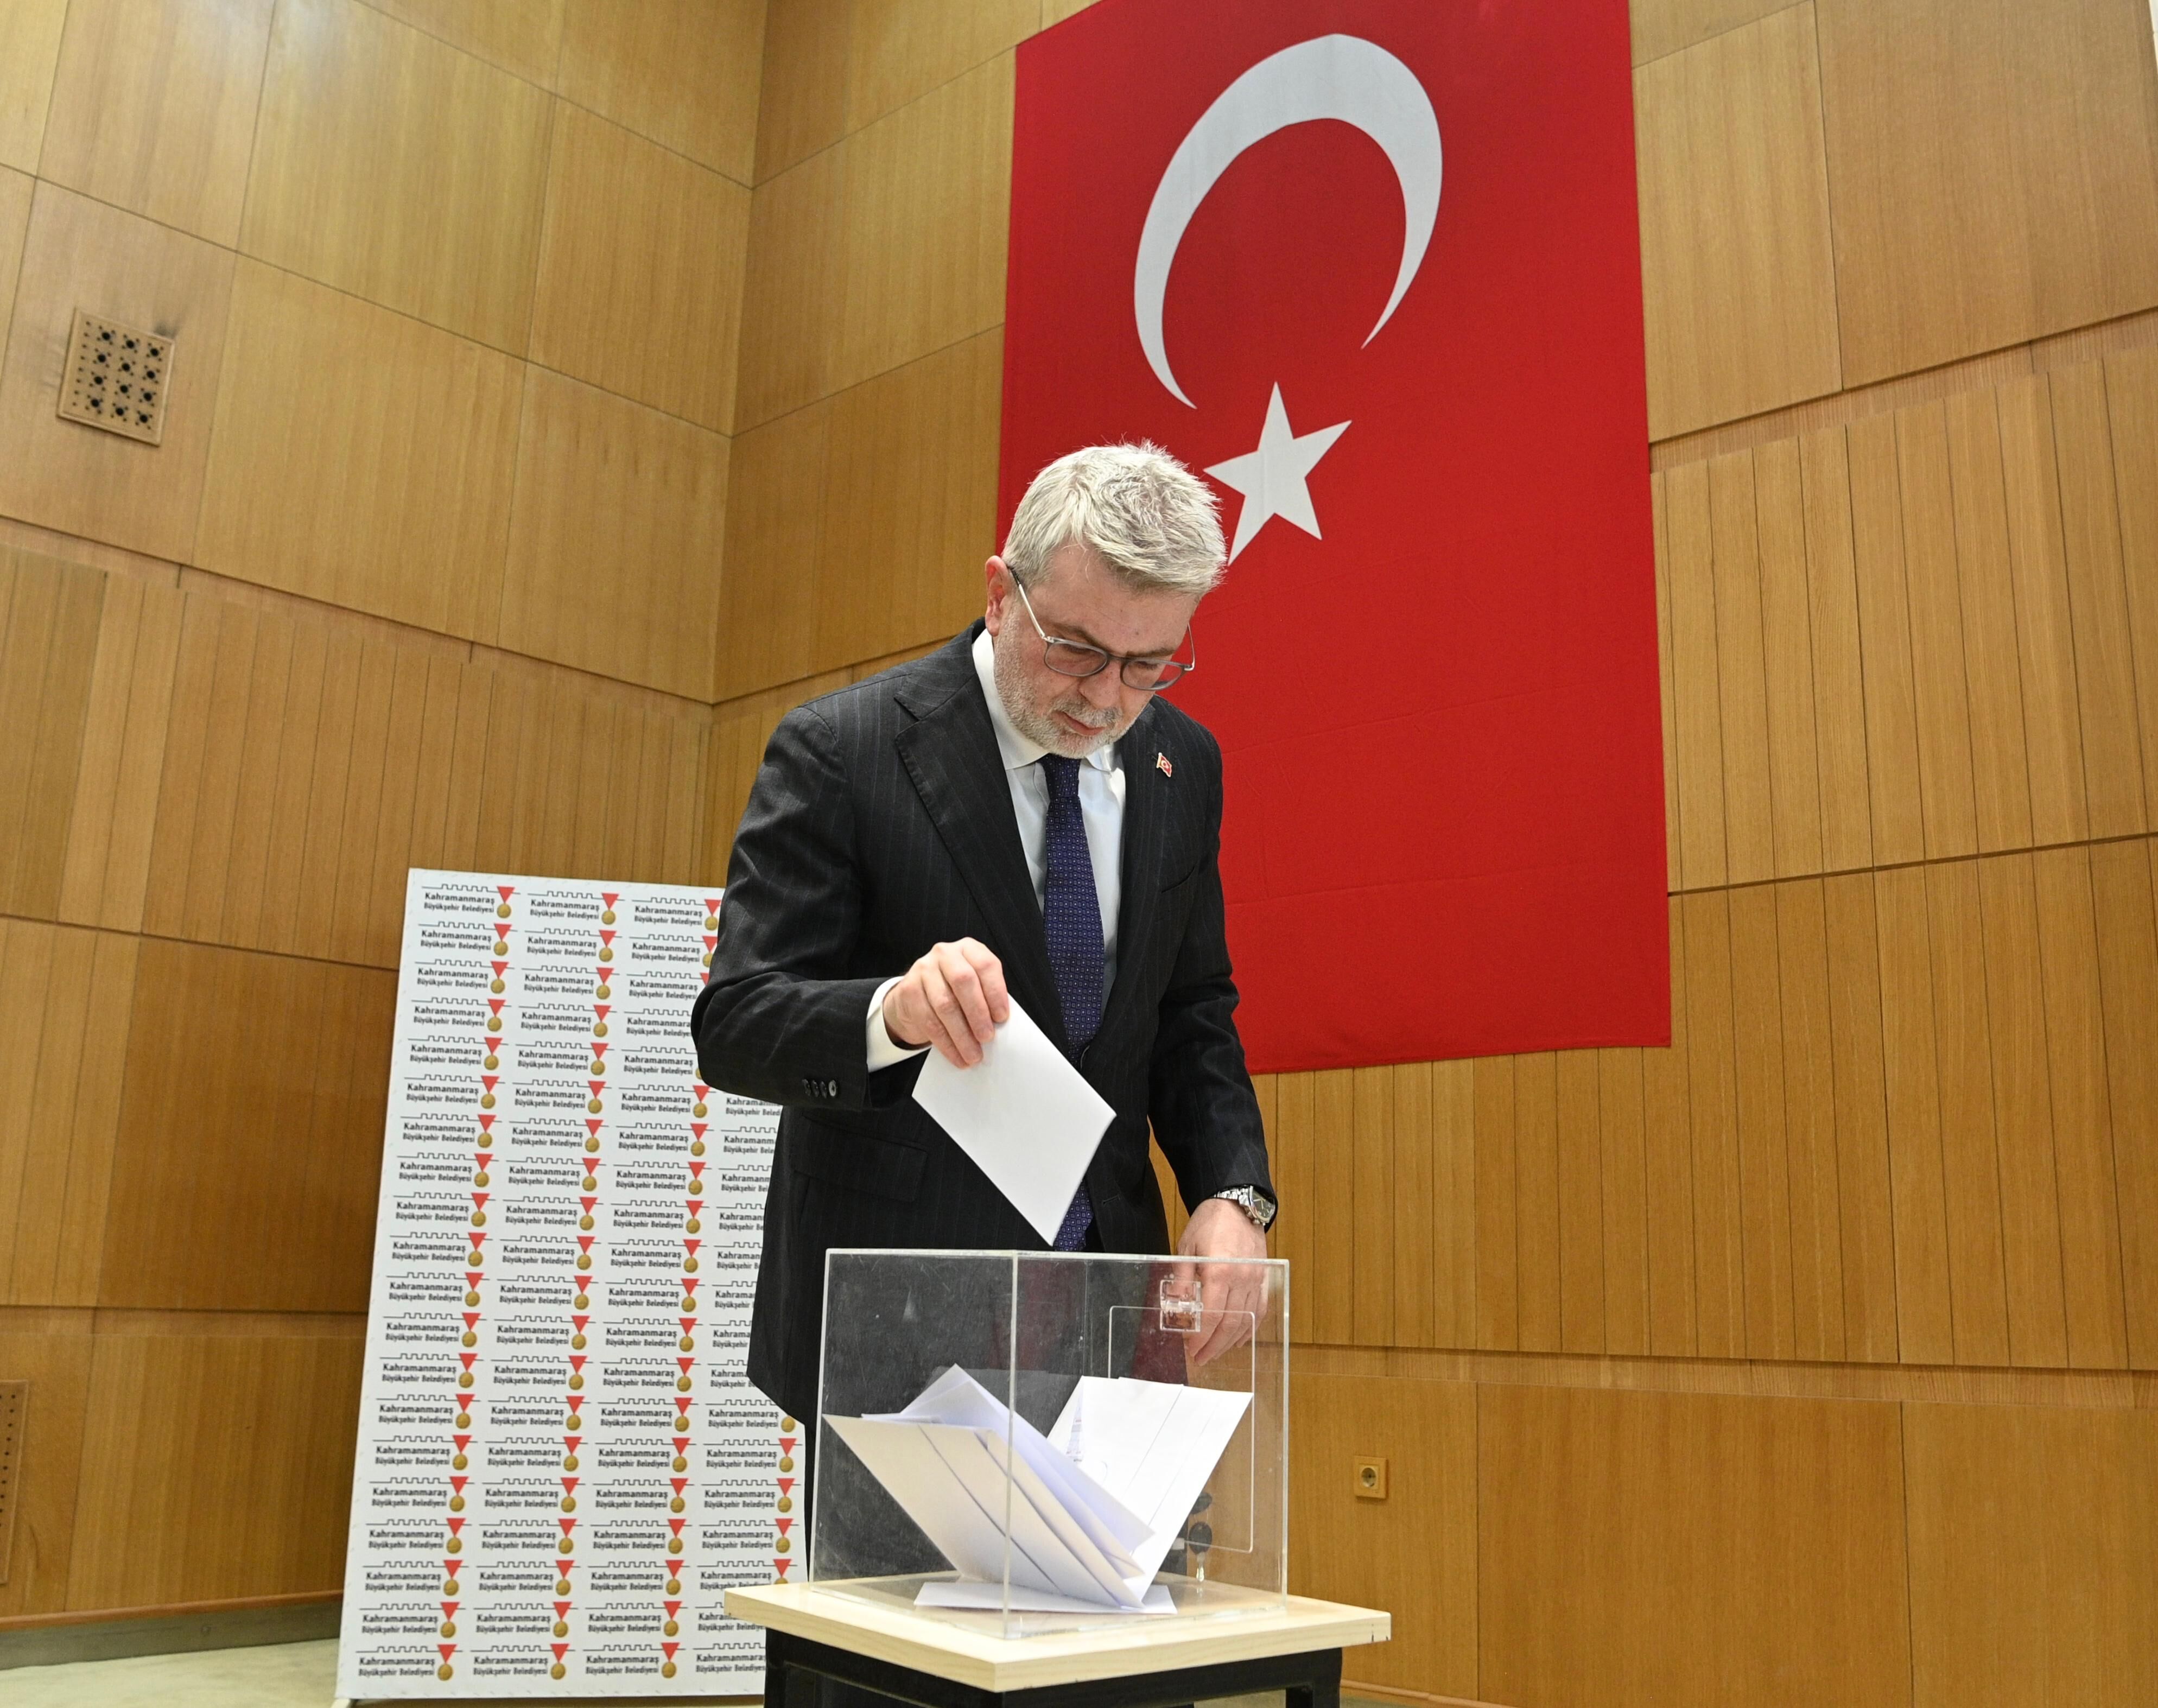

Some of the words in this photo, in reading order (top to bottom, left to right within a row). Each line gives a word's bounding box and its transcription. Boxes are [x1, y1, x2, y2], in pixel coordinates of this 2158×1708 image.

[424, 892, 495, 905] Kahramanmaraş
[423, 901, 460, 912] Büyükşehir
[461, 904, 495, 914] Belediyesi
[530, 898, 600, 912] Kahramanmaraş
[529, 909, 565, 919] Büyükşehir
[567, 910, 600, 921] Belediyesi
[634, 905, 702, 918] Kahramanmaraş
[421, 929, 492, 942] Kahramanmaraş
[420, 939, 456, 950] Büyükşehir
[458, 941, 492, 951] Belediyesi
[527, 936, 597, 949] Kahramanmaraş
[526, 945, 562, 956] Büyükşehir
[564, 948, 597, 958] Belediyesi
[632, 942, 700, 955] Kahramanmaraş
[417, 967, 488, 980] Kahramanmaraş
[416, 977, 453, 988] Büyükşehir
[454, 979, 488, 989] Belediyesi
[524, 973, 594, 986] Kahramanmaraş
[524, 983, 560, 994] Büyükşehir
[561, 985, 594, 995] Belediyesi
[630, 979, 698, 992] Kahramanmaraş
[414, 1005, 485, 1018] Kahramanmaraş
[413, 1015, 450, 1026] Büyükşehir
[451, 1017, 485, 1027] Belediyesi
[521, 1011, 592, 1024] Kahramanmaraş
[521, 1021, 556, 1032] Büyükşehir
[558, 1023, 591, 1033] Belediyesi
[410, 1044, 483, 1057] Kahramanmaraş
[518, 1049, 589, 1062] Kahramanmaraş
[409, 1054, 447, 1064] Büyükşehir
[448, 1056, 482, 1066] Belediyesi
[517, 1059, 554, 1070] Büyükşehir
[555, 1061, 588, 1071] Belediyesi
[624, 1055, 693, 1067] Kahramanmaraş
[623, 1064, 659, 1075] Büyükşehir
[660, 1066, 693, 1076] Belediyesi
[407, 1083, 479, 1095] Kahramanmaraş
[515, 1088, 586, 1100] Kahramanmaraş
[515, 1098, 550, 1108] Büyükşehir
[552, 1100, 586, 1110] Belediyesi
[621, 1093, 691, 1104] Kahramanmaraş
[621, 1103, 657, 1113] Büyükşehir
[658, 1104, 691, 1114] Belediyesi
[403, 1122, 475, 1134] Kahramanmaraş
[512, 1127, 583, 1139] Kahramanmaraş
[402, 1132, 440, 1142] Büyükşehir
[441, 1133, 475, 1144] Belediyesi
[511, 1137, 548, 1147] Büyükşehir
[549, 1138, 583, 1148] Belediyesi
[619, 1131, 688, 1143] Kahramanmaraş
[618, 1141, 654, 1151] Büyükşehir
[655, 1142, 688, 1153] Belediyesi
[399, 1161, 472, 1173] Kahramanmaraş
[509, 1165, 580, 1178] Kahramanmaraş
[398, 1172, 436, 1182] Büyükşehir
[437, 1173, 472, 1183] Belediyesi
[616, 1170, 686, 1182] Kahramanmaraş
[508, 1176, 545, 1186] Büyükşehir
[546, 1177, 580, 1188] Belediyesi
[615, 1180, 651, 1190] Büyükşehir
[653, 1181, 686, 1191] Belediyesi
[396, 1201, 469, 1213] Kahramanmaraş
[506, 1205, 577, 1217] Kahramanmaraş
[395, 1211, 433, 1222] Büyükşehir
[434, 1212, 469, 1223] Belediyesi
[613, 1209, 684, 1220] Kahramanmaraş
[505, 1215, 542, 1226] Büyükşehir
[543, 1216, 577, 1227] Belediyesi
[613, 1219, 649, 1229] Büyükşehir
[650, 1220, 683, 1230] Belediyesi
[392, 1241, 466, 1253] Kahramanmaraş
[503, 1245, 575, 1256] Kahramanmaraş
[611, 1248, 681, 1259] Kahramanmaraş
[502, 1255, 539, 1265] Büyükşehir
[541, 1256, 574, 1266] Belediyesi
[611, 1258, 646, 1268] Büyükşehir
[648, 1259, 681, 1269] Belediyesi
[389, 1281, 463, 1293] Kahramanmaraş
[500, 1284, 572, 1296] Kahramanmaraş
[608, 1287, 679, 1299] Kahramanmaraş
[499, 1295, 536, 1305] Büyükşehir
[538, 1296, 572, 1306] Belediyesi
[608, 1298, 644, 1308] Büyükşehir
[645, 1298, 679, 1309] Belediyesi
[386, 1322, 460, 1333] Kahramanmaraş
[497, 1324, 569, 1336] Kahramanmaraş
[606, 1327, 677, 1338] Kahramanmaraş
[496, 1335, 534, 1345] Büyükşehir
[535, 1336, 569, 1346] Belediyesi
[605, 1338, 642, 1348] Büyükşehir
[643, 1338, 677, 1348] Belediyesi
[383, 1362, 456, 1374] Kahramanmaraş
[494, 1364, 567, 1376] Kahramanmaraş
[604, 1367, 675, 1378] Kahramanmaraş
[382, 1374, 420, 1384] Büyükşehir
[421, 1374, 456, 1385] Belediyesi
[493, 1376, 530, 1386] Büyükşehir
[532, 1376, 567, 1386] Belediyesi
[603, 1377, 639, 1388] Büyükşehir
[640, 1378, 675, 1388] Belediyesi
[379, 1404, 453, 1415] Kahramanmaraş
[491, 1405, 564, 1417] Kahramanmaraş
[601, 1407, 672, 1418] Kahramanmaraş
[708, 1408, 778, 1419] Kahramanmaraş
[490, 1417, 528, 1427] Büyükşehir
[529, 1417, 564, 1427] Belediyesi
[600, 1418, 637, 1428] Büyükşehir
[638, 1418, 672, 1428] Belediyesi
[708, 1419, 744, 1429] Büyükşehir
[745, 1419, 778, 1430] Belediyesi
[376, 1445, 450, 1456] Kahramanmaraş
[488, 1446, 561, 1458] Kahramanmaraş
[599, 1447, 670, 1459] Kahramanmaraş
[707, 1448, 777, 1459] Kahramanmaraş
[598, 1459, 634, 1469] Büyükşehir
[636, 1459, 670, 1469] Belediyesi
[706, 1459, 742, 1469] Büyükşehir
[744, 1459, 777, 1469] Belediyesi
[372, 1487, 447, 1497] Kahramanmaraş
[485, 1488, 558, 1499] Kahramanmaraş
[596, 1488, 668, 1499] Kahramanmaraş
[704, 1489, 775, 1500] Kahramanmaraş
[595, 1500, 632, 1510] Büyükşehir
[633, 1500, 668, 1510] Belediyesi
[704, 1500, 740, 1510] Büyükşehir
[741, 1500, 775, 1510] Belediyesi
[369, 1528, 444, 1540] Kahramanmaraş
[483, 1529, 556, 1540] Kahramanmaraş
[594, 1529, 666, 1540] Kahramanmaraş
[702, 1529, 773, 1540] Kahramanmaraş
[593, 1541, 630, 1551] Büyükşehir
[631, 1541, 665, 1551] Belediyesi
[702, 1540, 738, 1551] Büyükşehir
[740, 1540, 773, 1550] Belediyesi
[366, 1571, 441, 1582] Kahramanmaraş
[479, 1571, 554, 1582] Kahramanmaraş
[591, 1571, 663, 1582] Kahramanmaraş
[700, 1570, 771, 1580] Kahramanmaraş
[591, 1582, 627, 1592] Büyükşehir
[629, 1582, 663, 1592] Belediyesi
[362, 1614, 438, 1624] Kahramanmaraş
[477, 1613, 551, 1623] Kahramanmaraş
[589, 1612, 661, 1623] Kahramanmaraş
[588, 1623, 625, 1634] Büyükşehir
[627, 1623, 661, 1634] Belediyesi
[359, 1656, 435, 1666] Kahramanmaraş
[474, 1655, 548, 1666] Kahramanmaraş
[586, 1654, 659, 1665] Kahramanmaraş
[586, 1665, 623, 1676] Büyükşehir
[624, 1665, 659, 1675] Belediyesi
